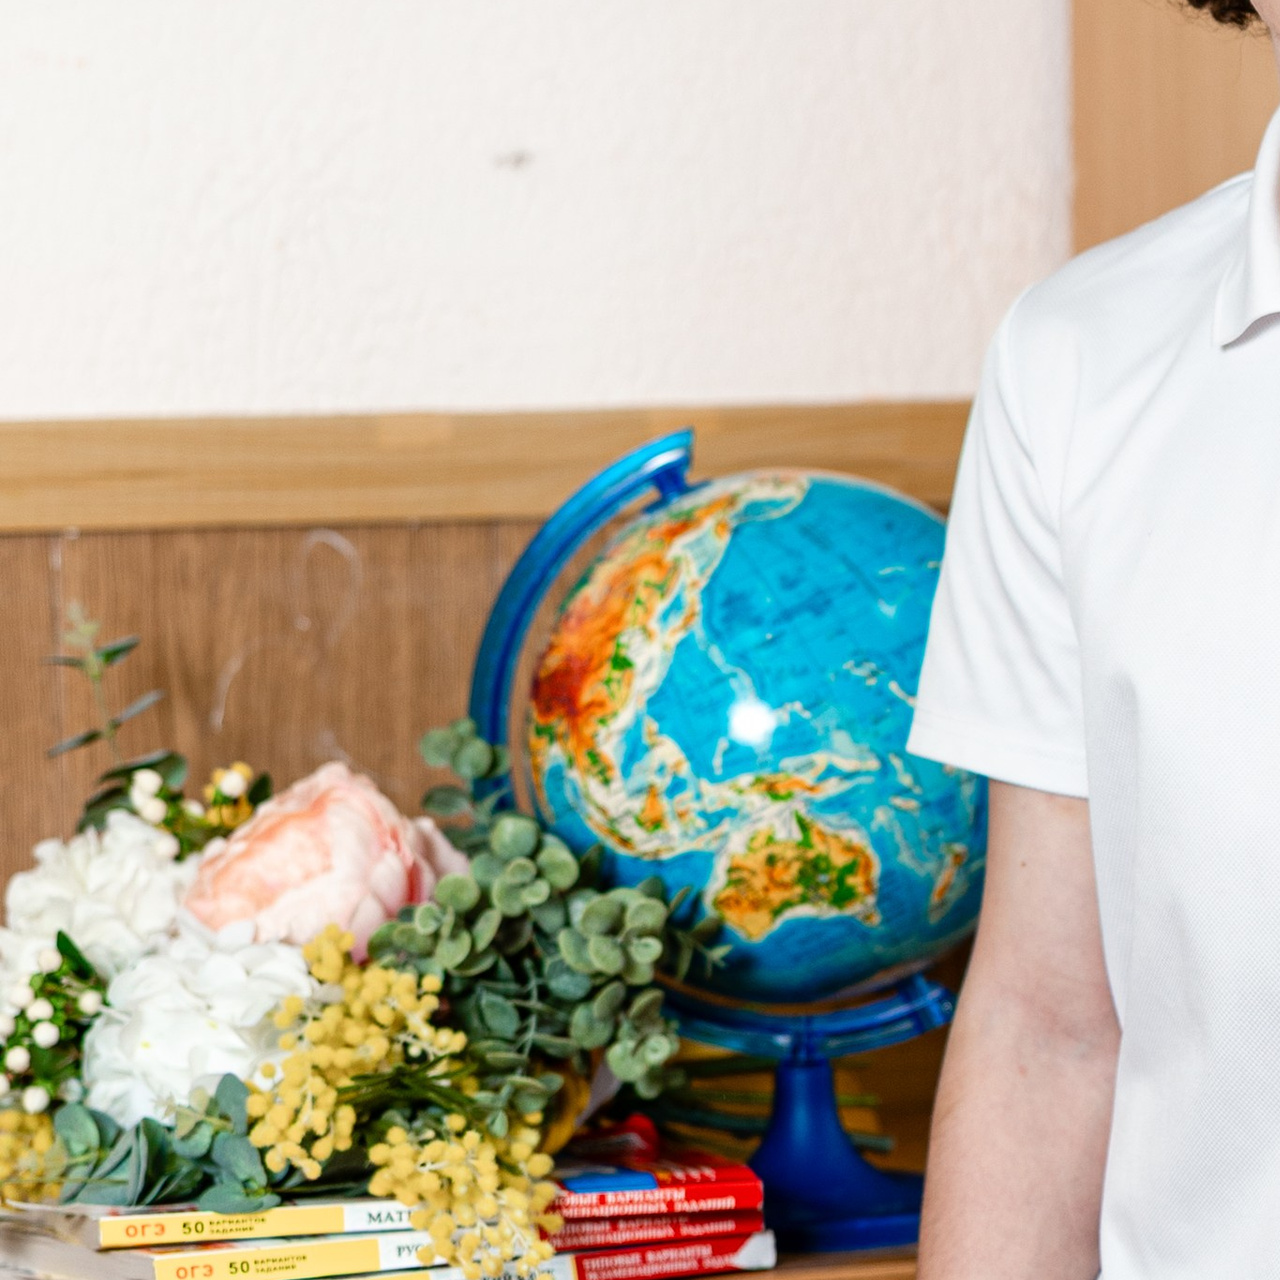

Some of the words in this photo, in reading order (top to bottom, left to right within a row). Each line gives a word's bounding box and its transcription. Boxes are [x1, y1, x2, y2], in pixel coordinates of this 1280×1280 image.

[607, 1188, 686, 1204] ВАРИАНТЫ
[561, 1198, 668, 1218] МЕНАЦИОННЫХ
[674, 1196, 736, 1212] ЗАДАНИЙ
[125, 1223, 166, 1237] ОГЭ
[182, 1221, 205, 1235] 50
[645, 1243, 713, 1264] ВАРИАНТЫ
[176, 1264, 214, 1279] ОГЭ
[229, 1260, 250, 1275] 50
